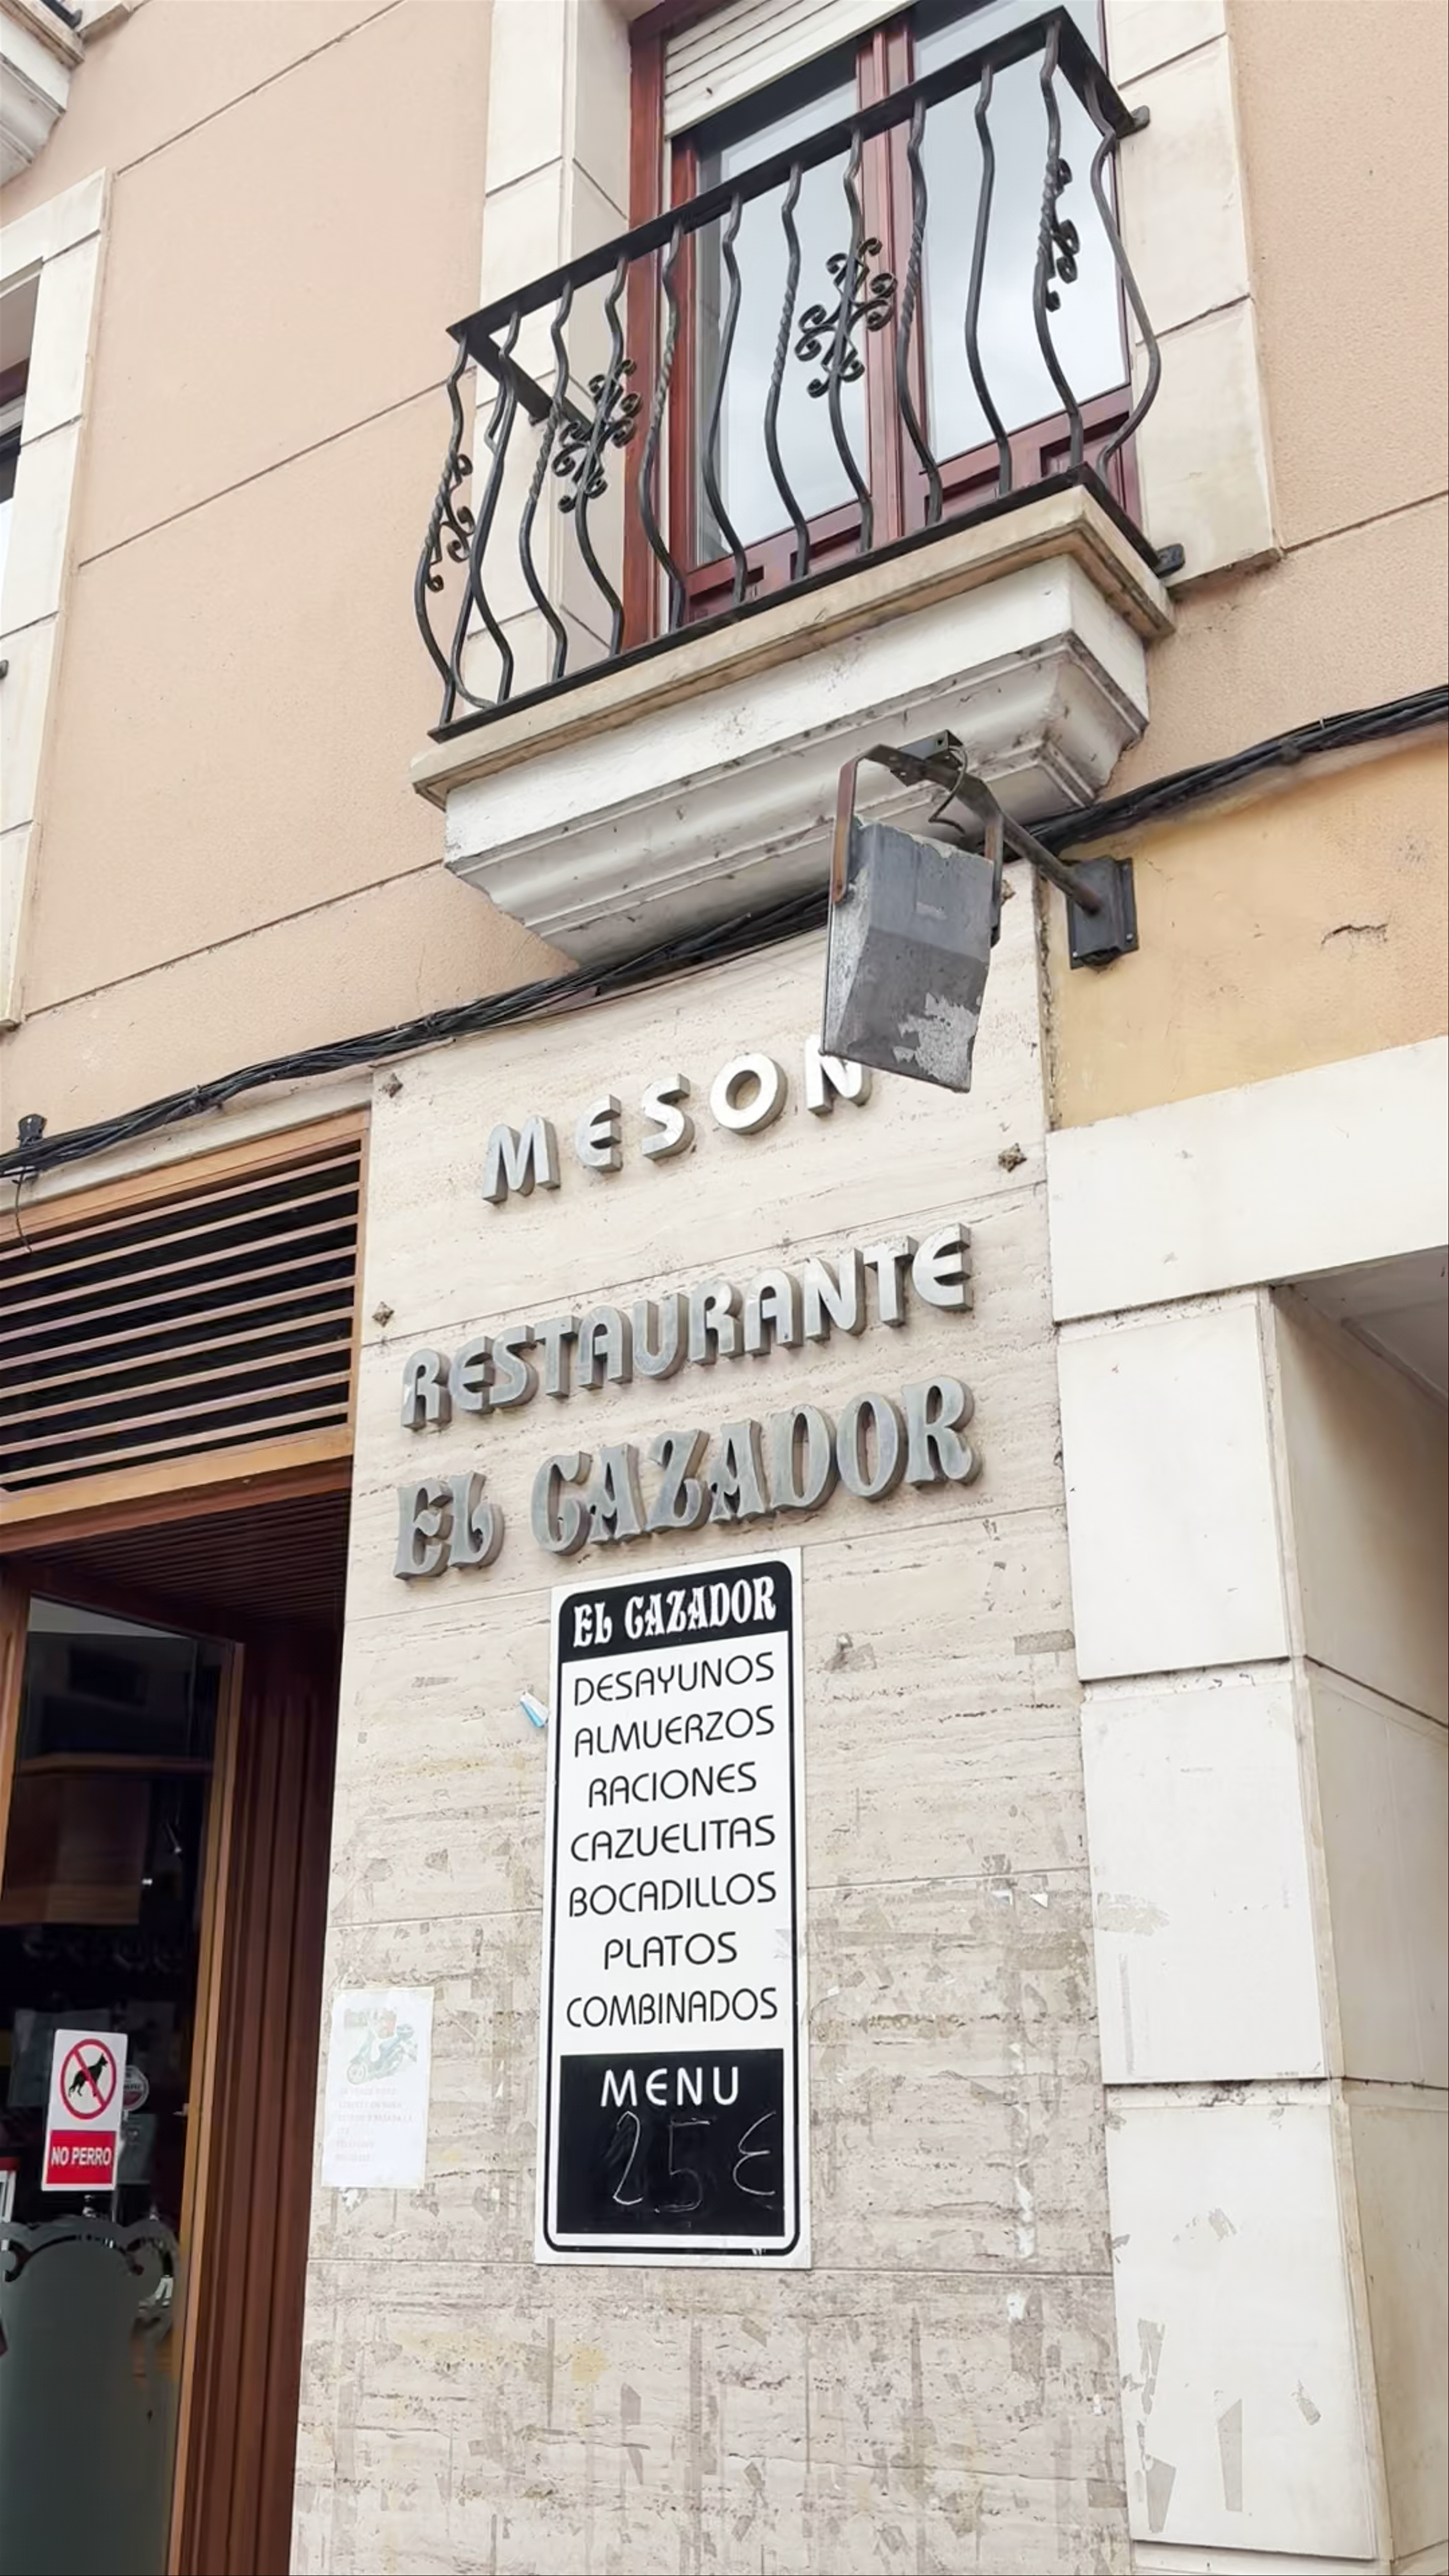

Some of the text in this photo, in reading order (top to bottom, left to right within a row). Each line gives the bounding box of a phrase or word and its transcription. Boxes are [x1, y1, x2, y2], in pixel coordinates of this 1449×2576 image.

[481, 1034, 873, 1204] MESON
[401, 1223, 974, 1429] RESTAURANTE
[393, 1472, 503, 1581] EL
[573, 1602, 612, 1648] EL
[574, 1652, 774, 1706] DESAYUNOS
[575, 1705, 774, 1758] ALMUERZOS
[589, 1761, 757, 1808] RACIONES
[571, 1815, 775, 1861] CAZUELITAS
[569, 1871, 776, 1917] BOCADILLOS
[605, 1932, 737, 1970] PLATOS
[566, 1988, 777, 2027] COMBINADOS
[600, 2066, 738, 2107] MENU
[51, 2146, 112, 2166] NO PERRO
